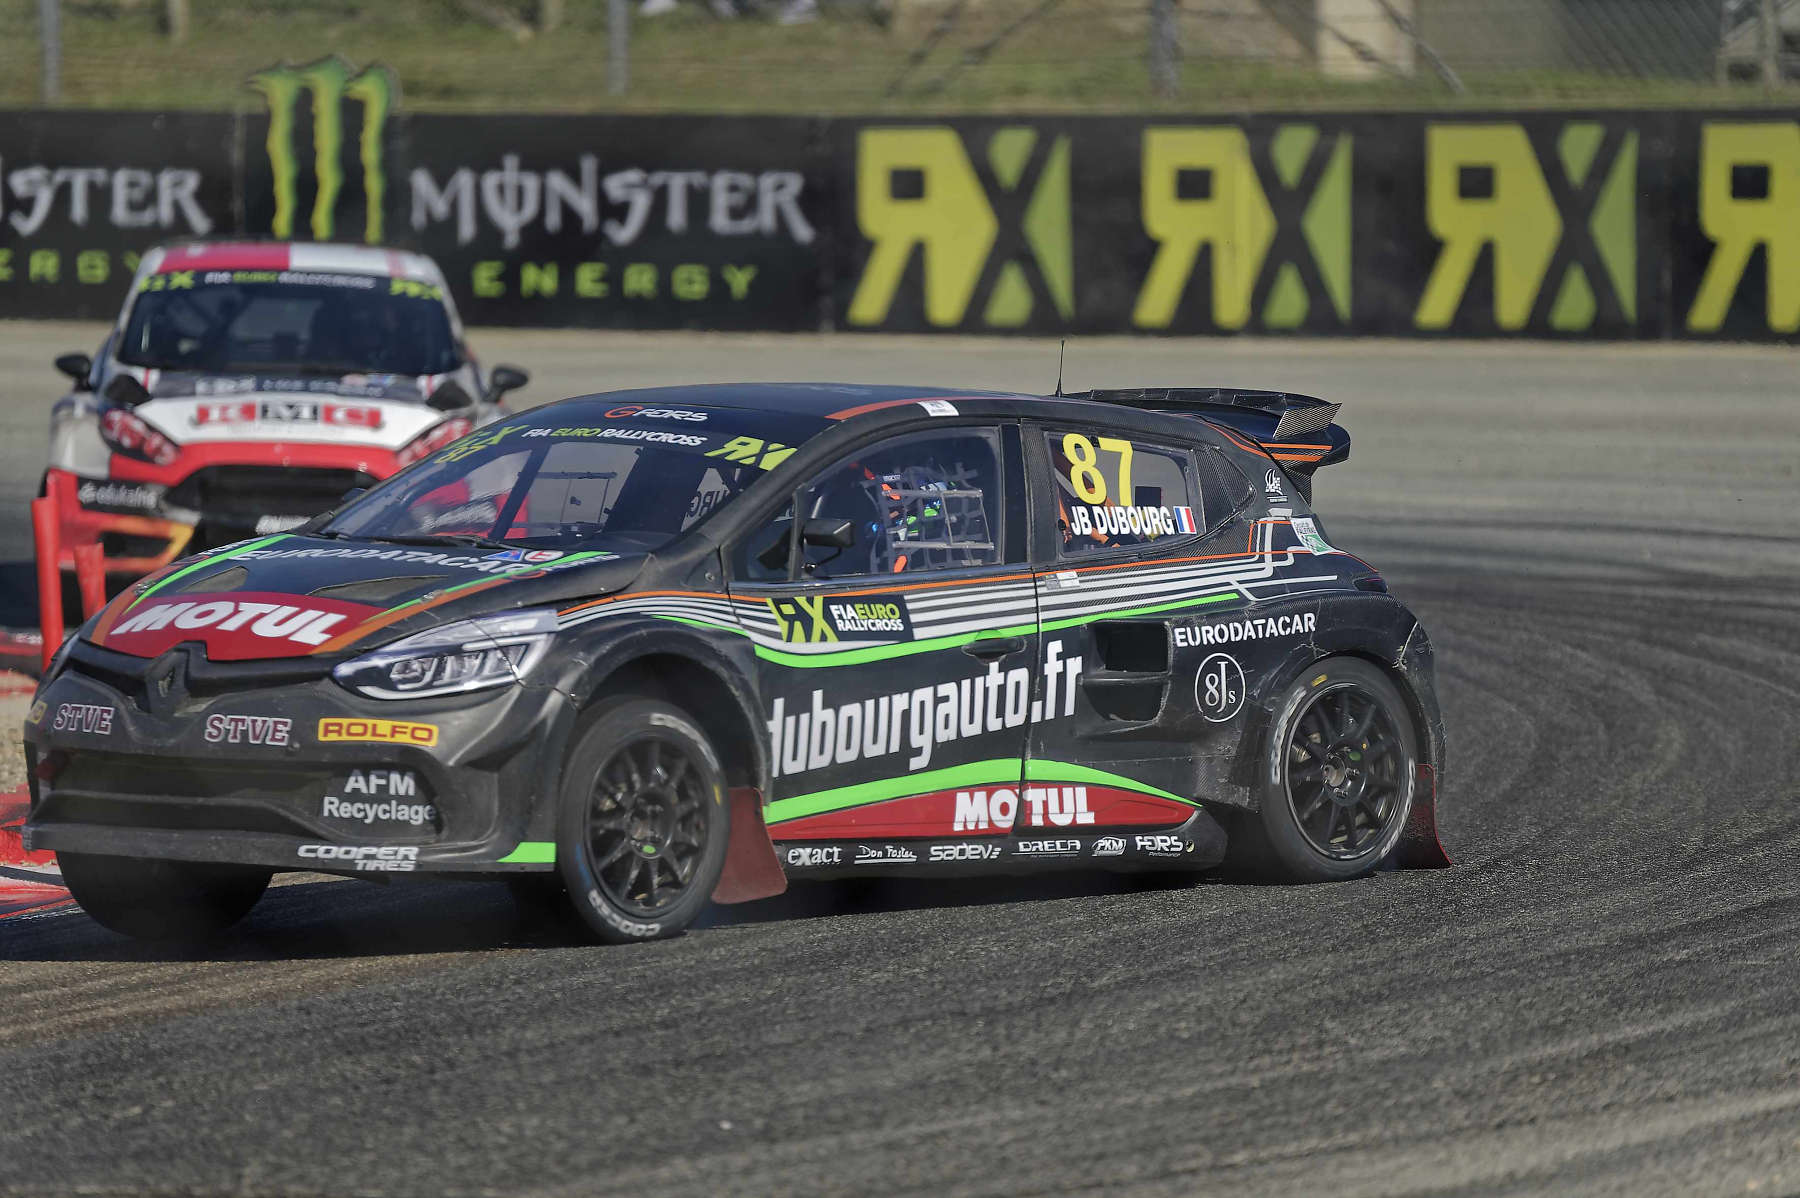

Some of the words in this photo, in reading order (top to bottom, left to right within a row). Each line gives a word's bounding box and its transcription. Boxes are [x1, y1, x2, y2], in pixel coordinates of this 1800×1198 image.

[0, 163, 213, 237] STER
[409, 153, 816, 250] MONSTER
[471, 260, 758, 300] ENERGY
[521, 428, 550, 439] FIA
[550, 428, 601, 438] EURO
[599, 428, 708, 447] RALLYCROSS
[1063, 433, 1133, 507] 87
[1071, 505, 1093, 536] JB
[1092, 505, 1176, 536] DUBOURG
[111, 601, 348, 646] MOTUL
[835, 618, 905, 633] RALLYCROSS
[1174, 612, 1316, 648] EURODATACAR
[53, 703, 115, 736] STVE
[205, 714, 292, 747] STVE
[322, 720, 434, 743] ROLFO
[344, 769, 416, 796] AFM
[323, 796, 437, 825] Recyclage
[953, 786, 1095, 832] MOTUL
[297, 844, 419, 861] COOPER
[354, 859, 416, 872] TIRES
[787, 846, 842, 866] exact
